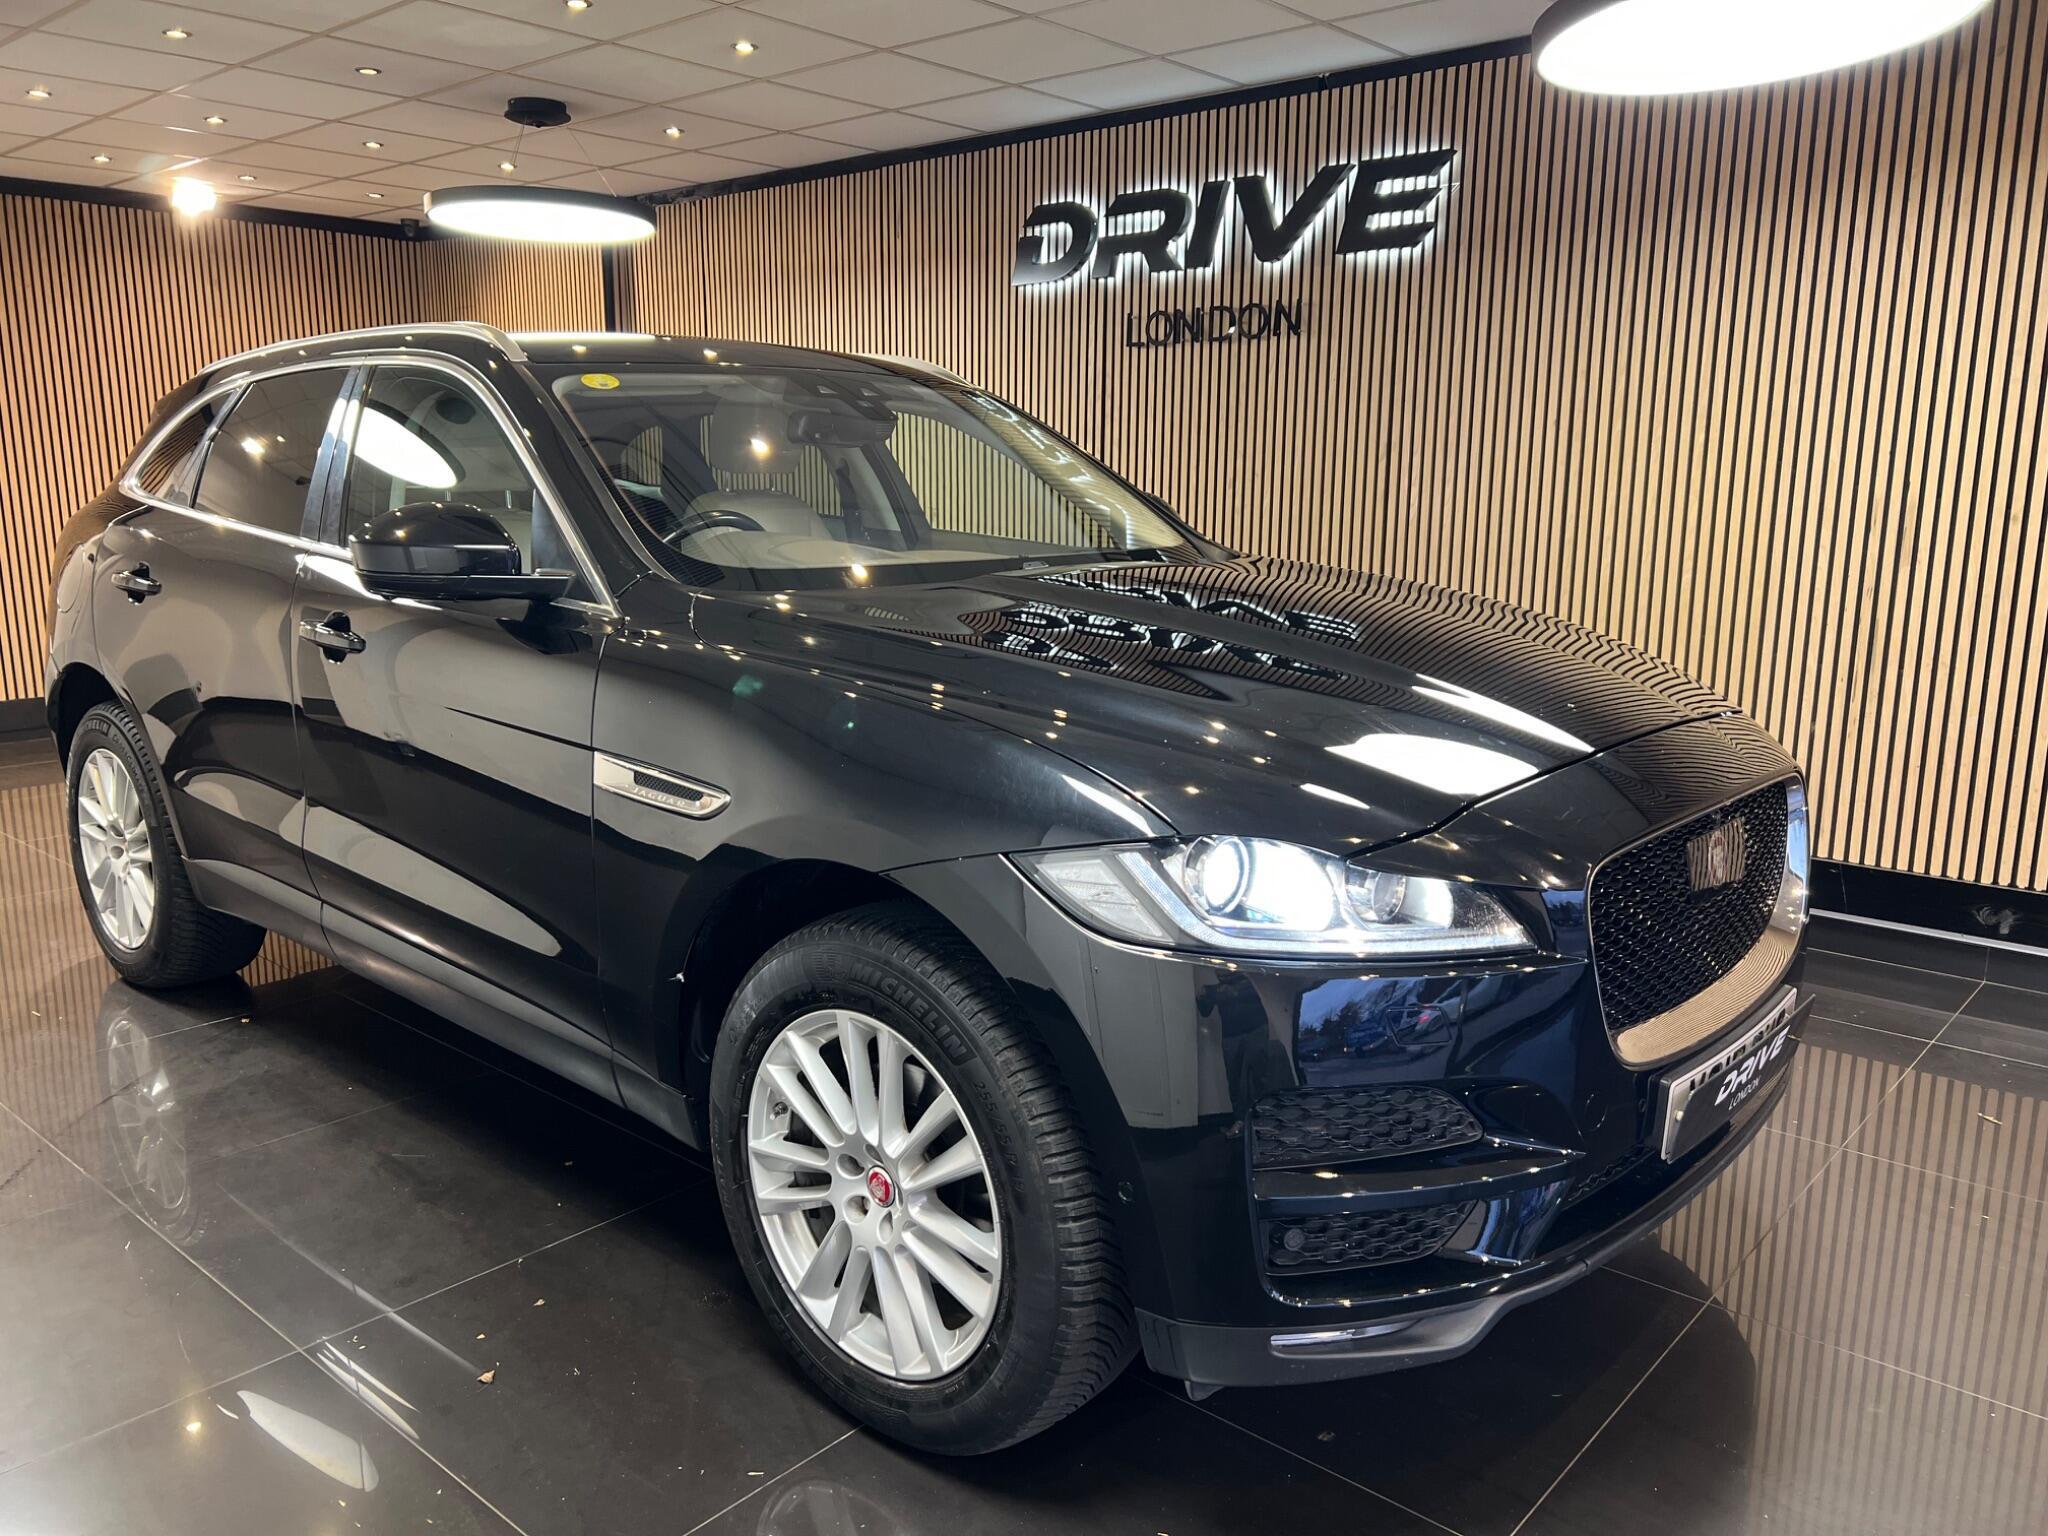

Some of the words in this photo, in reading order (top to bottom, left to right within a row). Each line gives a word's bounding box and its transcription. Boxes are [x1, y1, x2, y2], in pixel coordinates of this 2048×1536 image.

[1012, 148, 1457, 286] DRIVE
[1126, 300, 1301, 348] LONDON
[632, 787, 687, 807] JAGUAR
[851, 963, 968, 1058] MICHELIN
[1714, 1025, 1790, 1106] DRIVE
